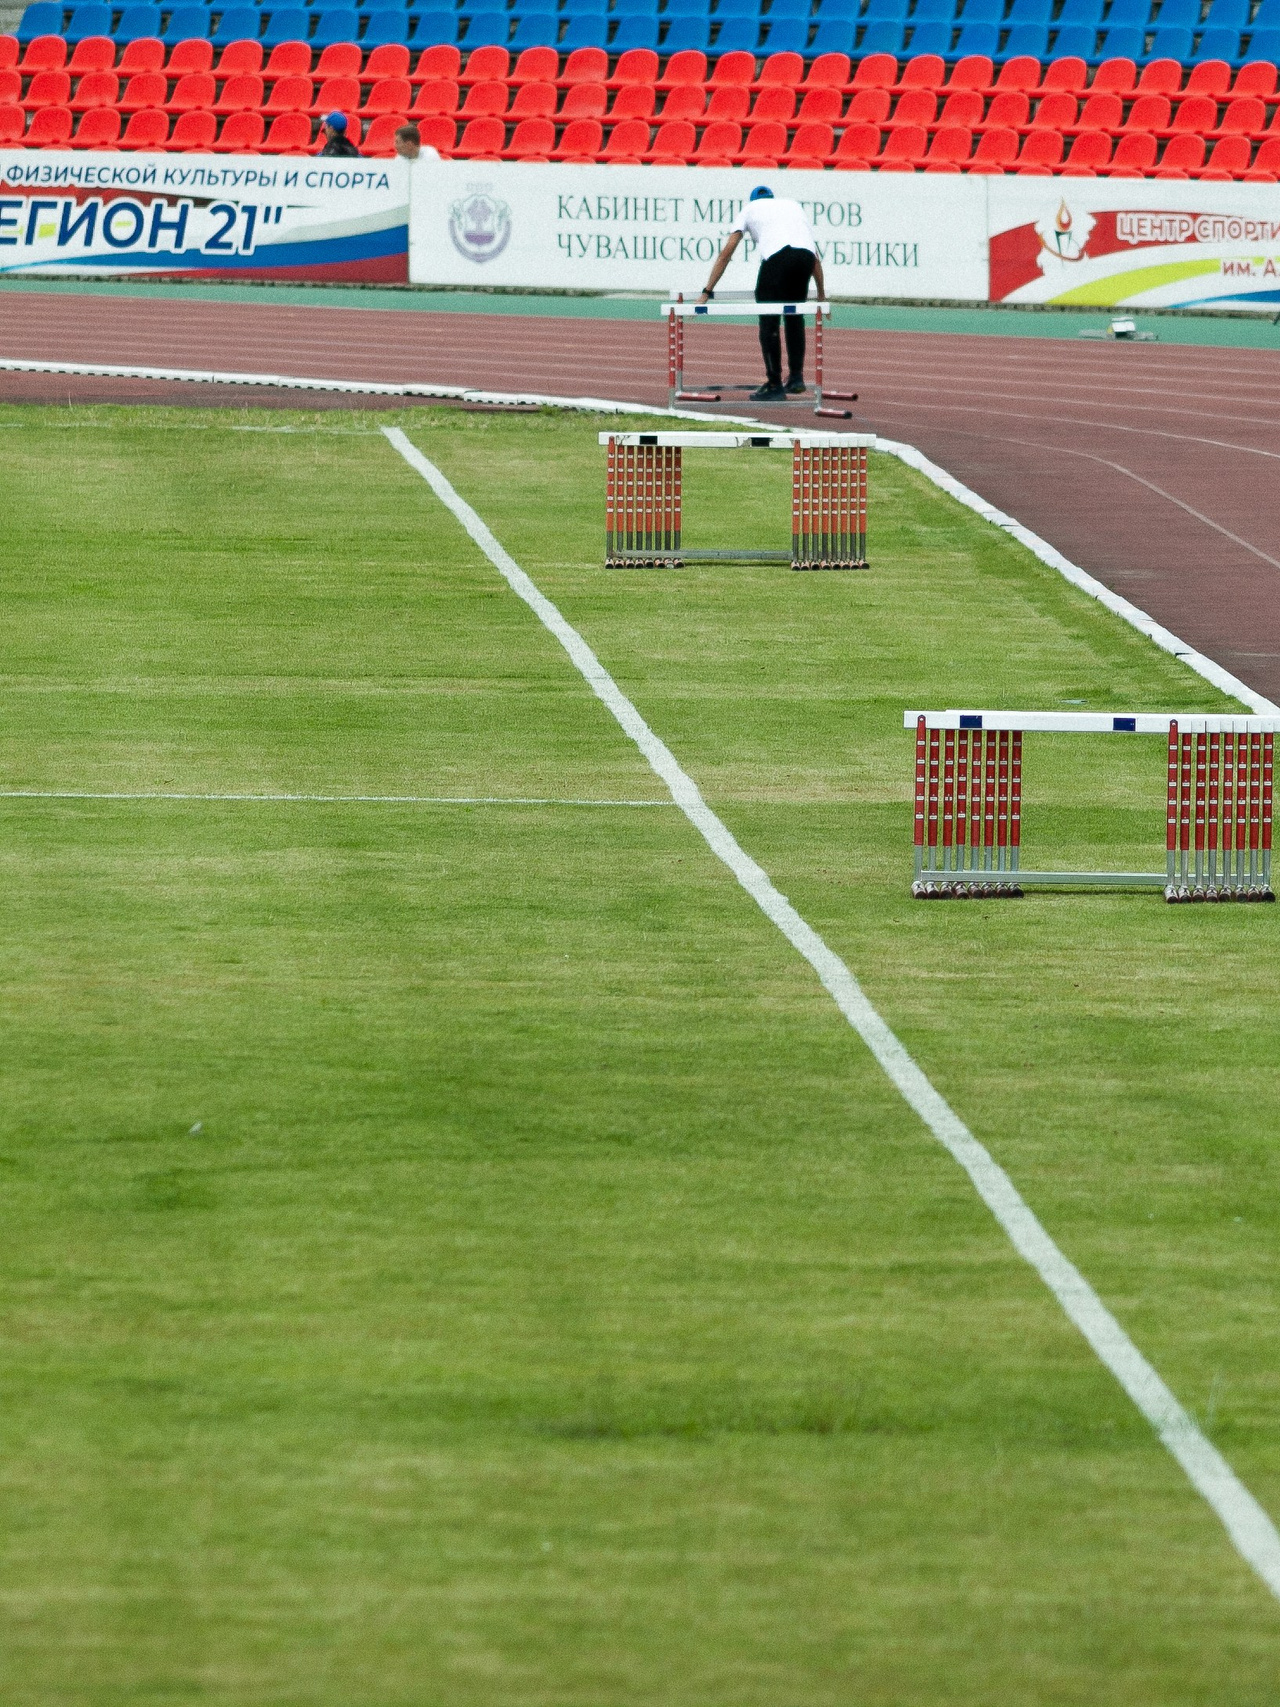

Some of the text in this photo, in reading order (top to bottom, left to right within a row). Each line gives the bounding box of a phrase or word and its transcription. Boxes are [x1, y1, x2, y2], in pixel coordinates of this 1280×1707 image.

[6, 163, 390, 190] ФИЗИЧЕСКОЙ КУЛЬТУРЫ И СПОРТА
[557, 194, 863, 227] КАБИНЕТ МИРОВ
[1118, 216, 1192, 239] ЦЕНТР
[744, 238, 919, 268] РУБЛИКИ
